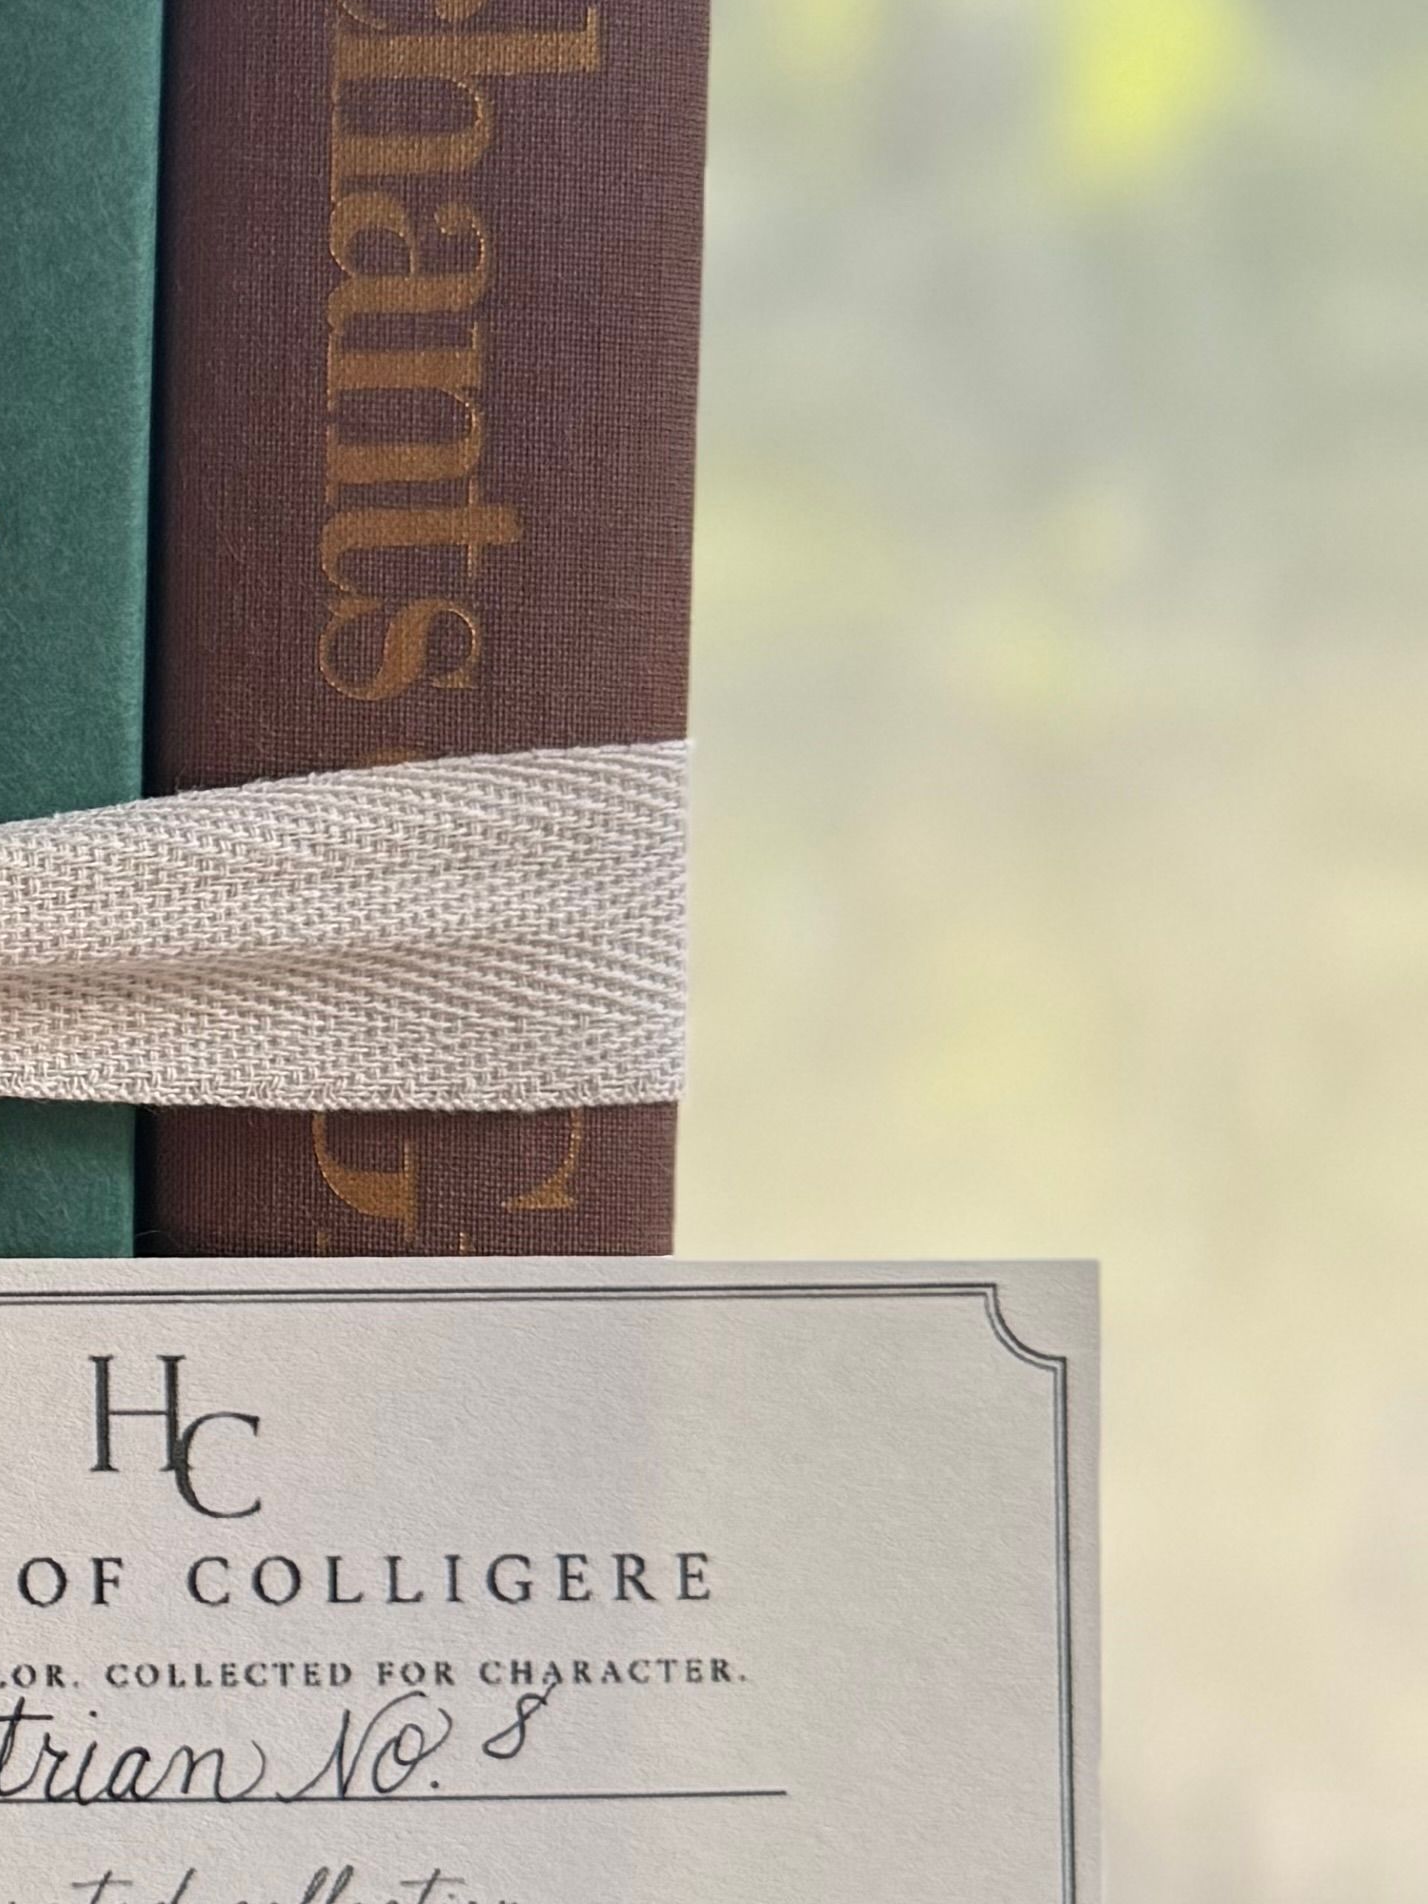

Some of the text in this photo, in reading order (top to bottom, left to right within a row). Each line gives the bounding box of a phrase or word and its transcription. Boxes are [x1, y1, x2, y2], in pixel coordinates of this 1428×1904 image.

[17, 1556, 124, 1608] OF
[186, 1551, 713, 1607] COLLIGERE
[105, 1660, 352, 1689] COLLECTED
[377, 1660, 457, 1687] FOR
[479, 1657, 748, 1685] CHARACTER.
[275, 1690, 453, 1803] No.
[482, 1682, 556, 1759] 8
